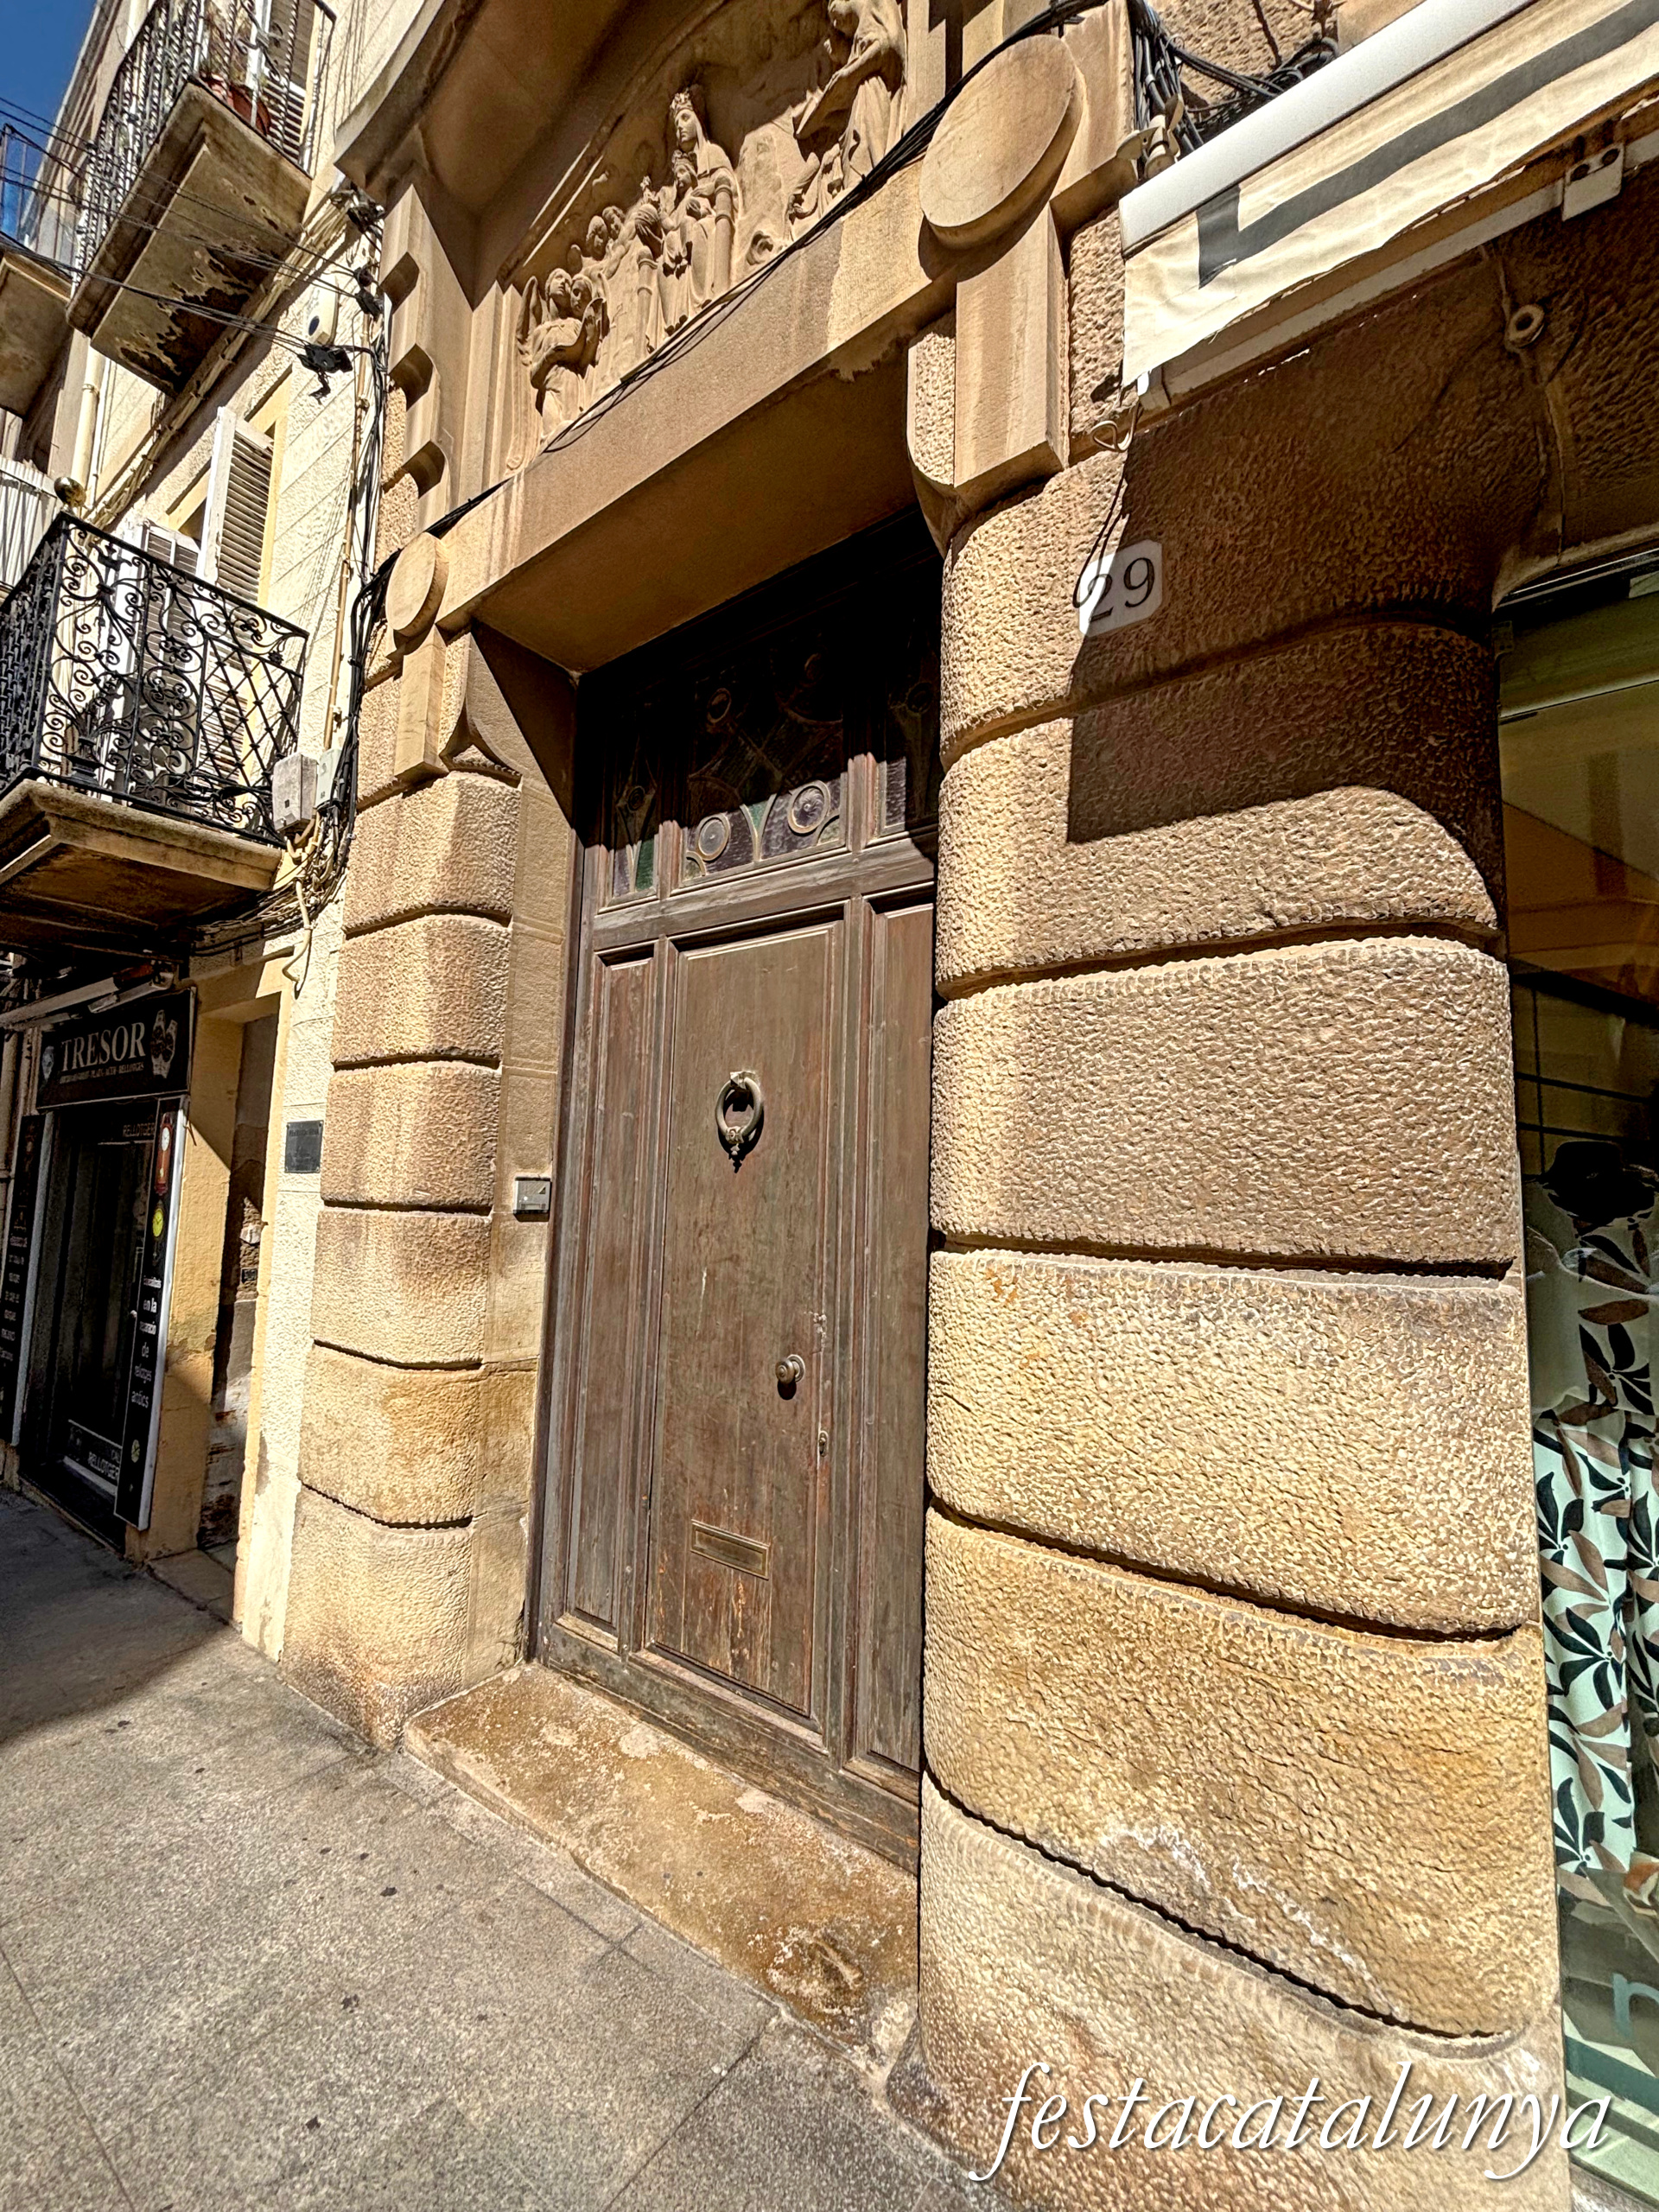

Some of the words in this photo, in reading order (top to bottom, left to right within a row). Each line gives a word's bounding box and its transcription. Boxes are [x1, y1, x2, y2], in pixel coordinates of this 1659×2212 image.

[1087, 557, 1155, 623] 29
[61, 1021, 146, 1071] TRESOR
[142, 1342, 149, 1357] de
